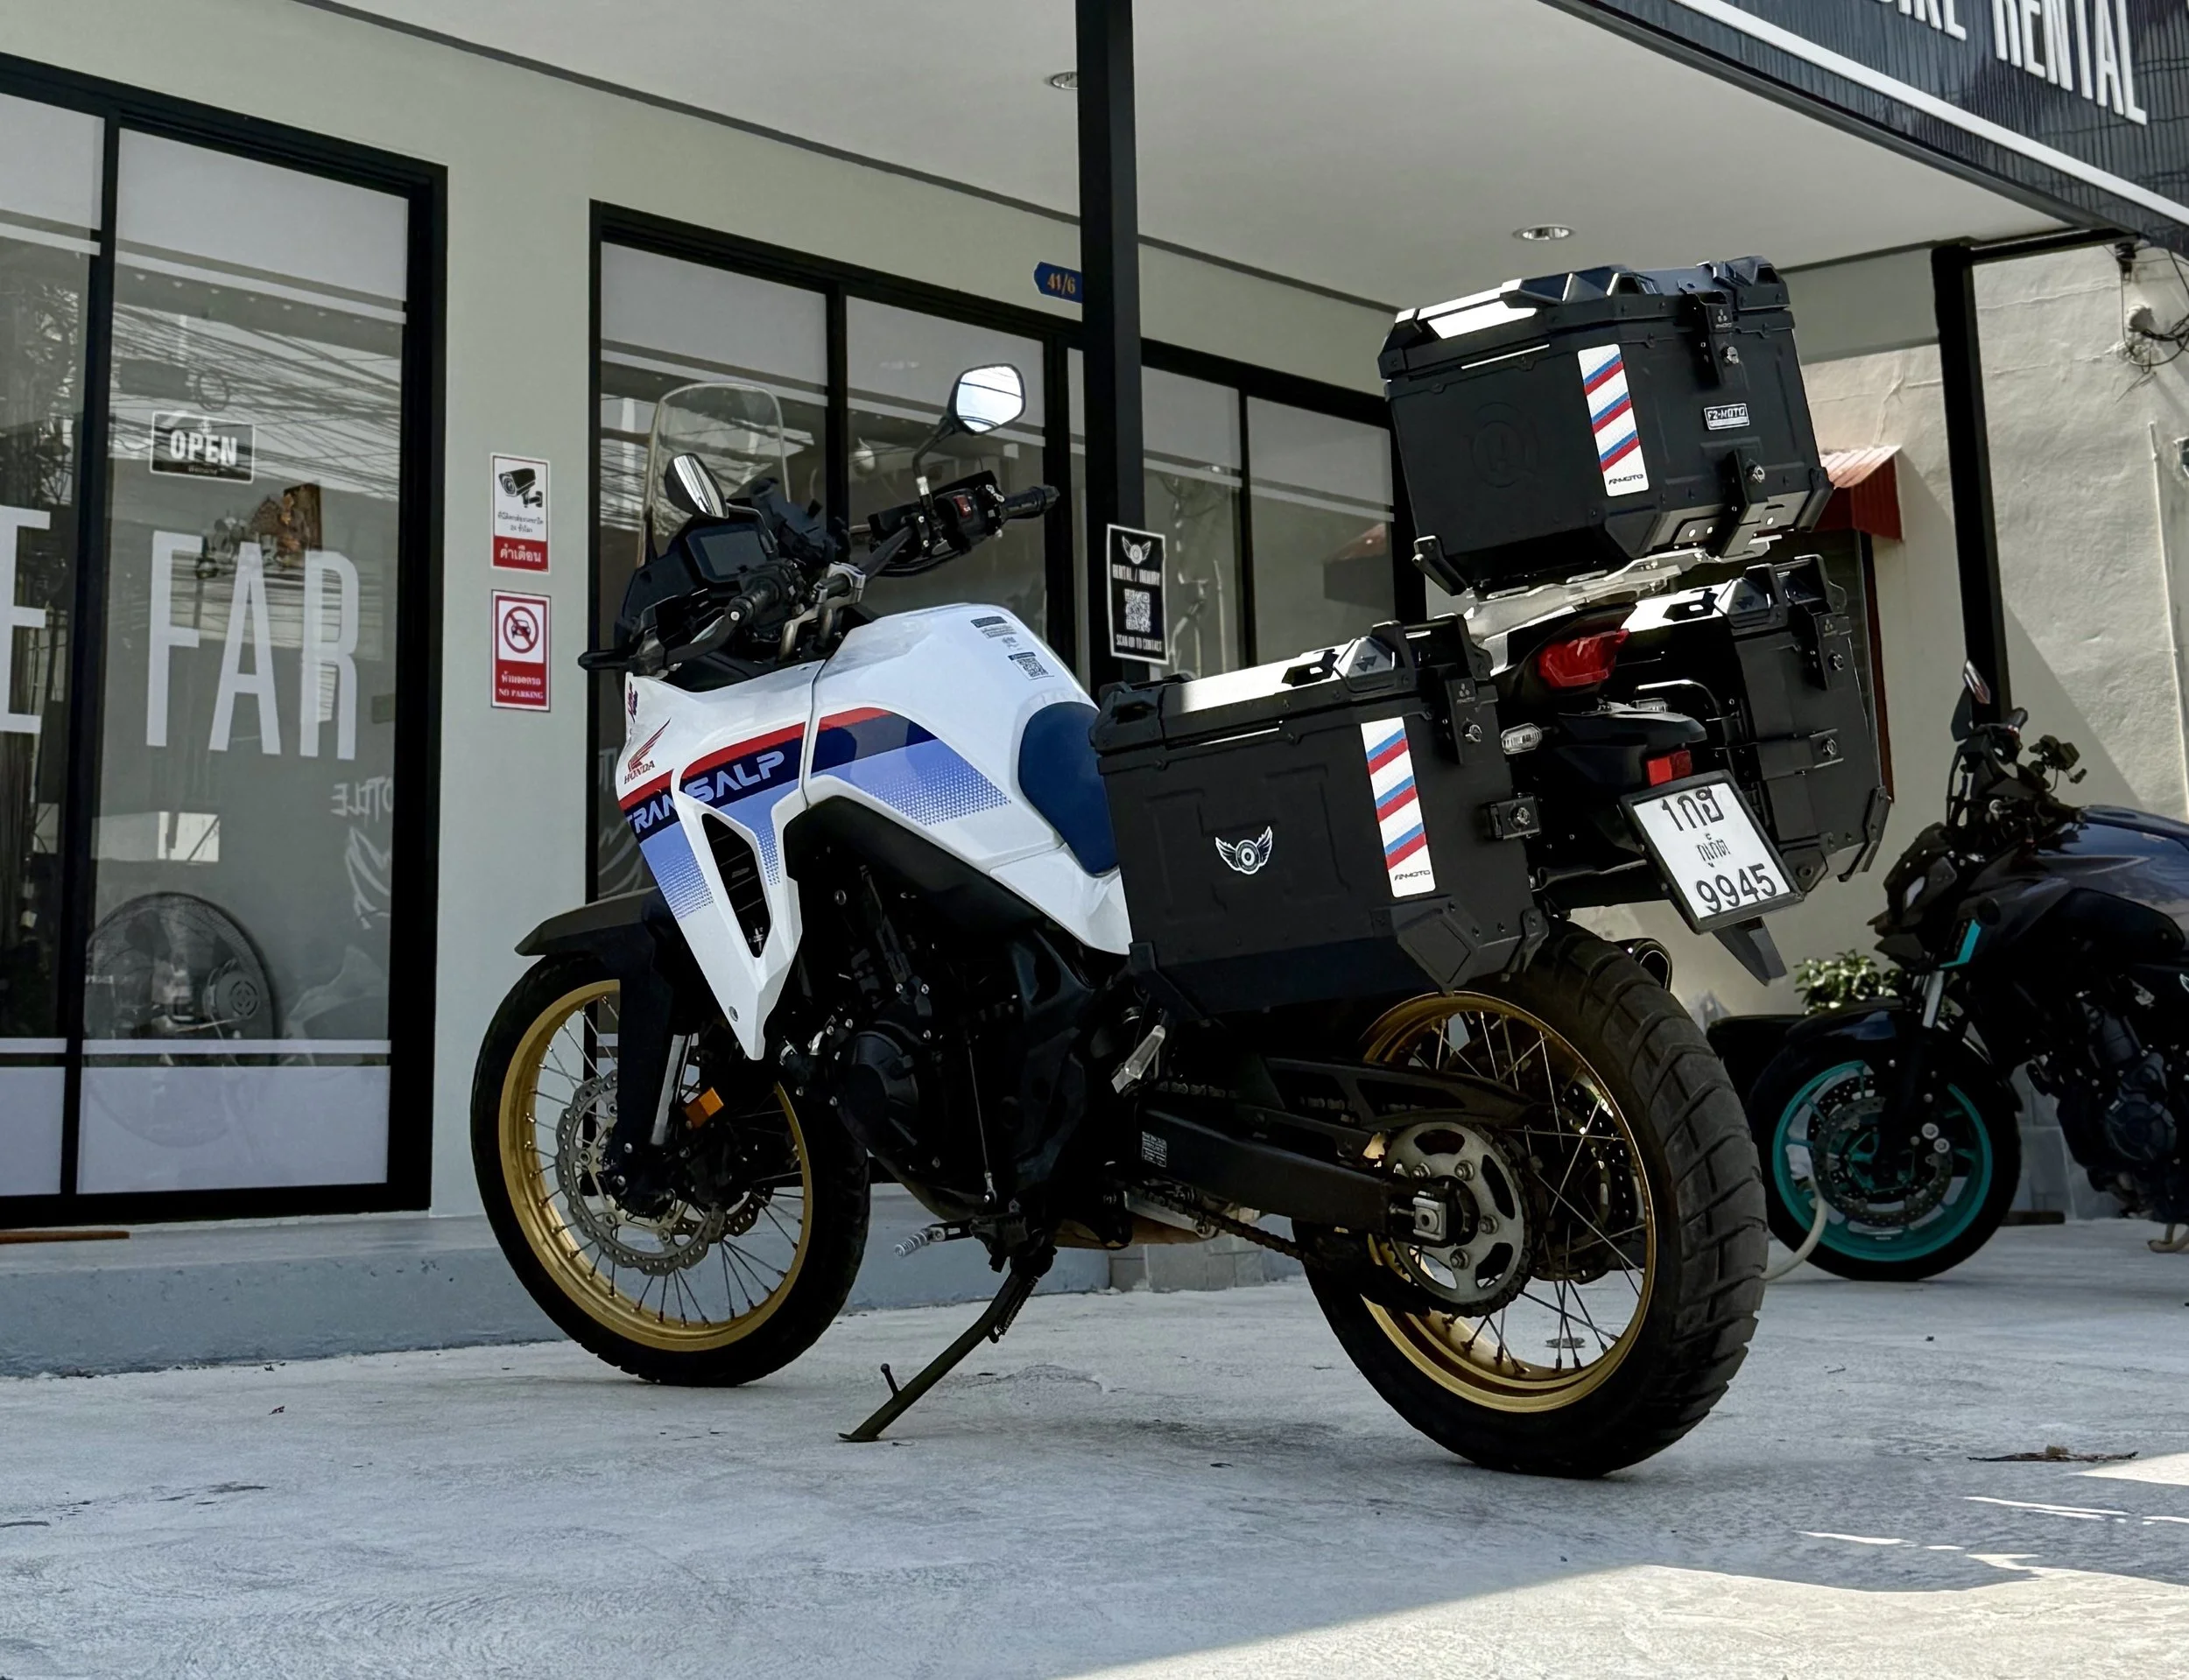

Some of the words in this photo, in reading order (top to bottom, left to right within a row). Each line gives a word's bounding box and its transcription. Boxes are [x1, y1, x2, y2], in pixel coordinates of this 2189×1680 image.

[1047, 273, 1076, 295] 41/6
[170, 430, 238, 467] OPEN
[500, 543, 541, 562] คำเตือน
[146, 530, 359, 760] FAR
[499, 688, 510, 697] NO
[511, 690, 544, 699] PARKING
[623, 760, 655, 784] HONDA
[1697, 833, 1731, 868] ภูเก็ต
[1696, 863, 1777, 913] 9945
